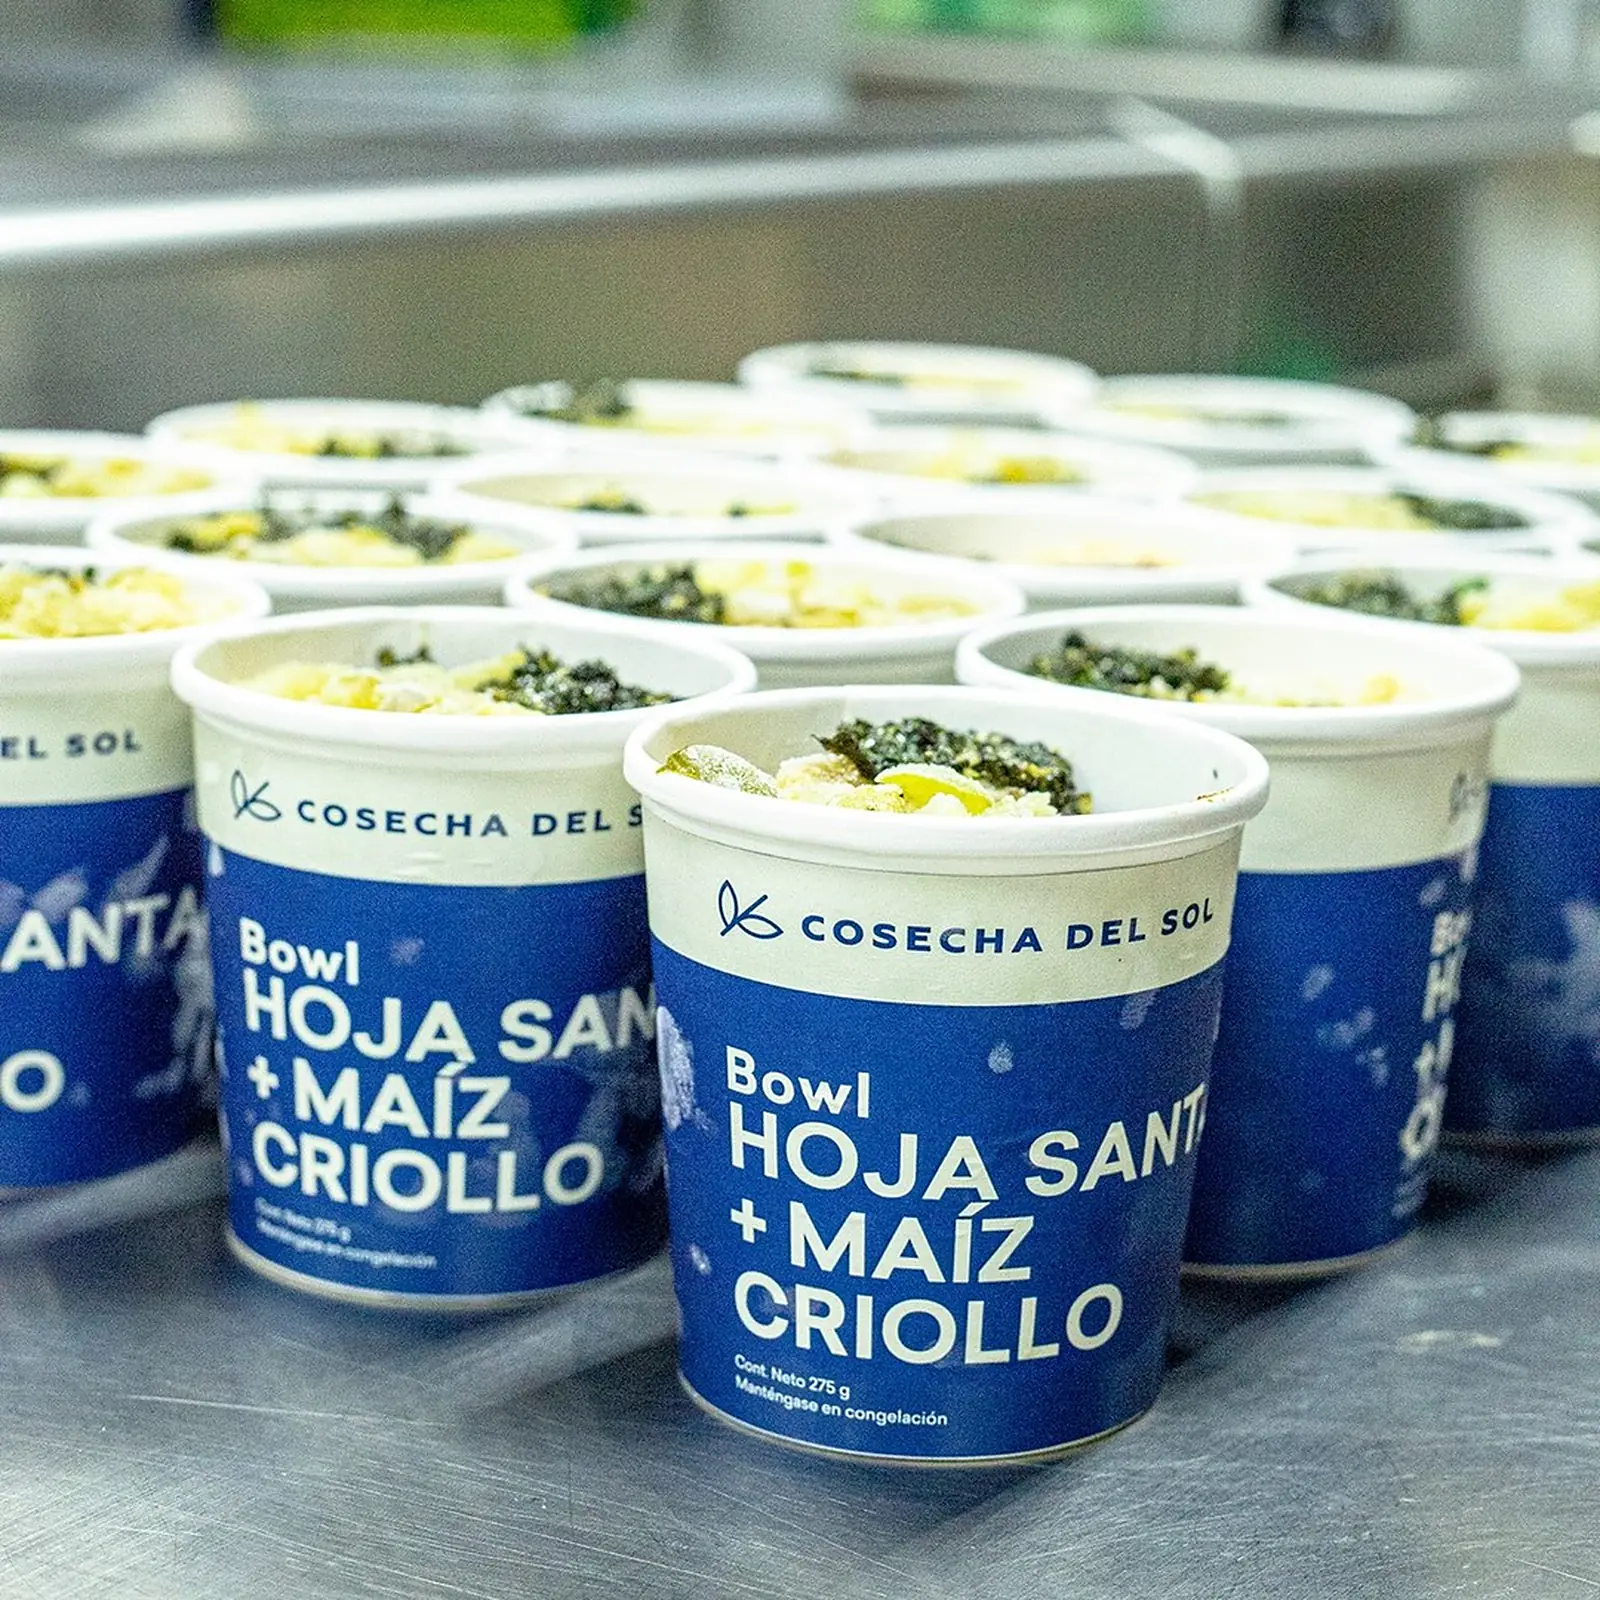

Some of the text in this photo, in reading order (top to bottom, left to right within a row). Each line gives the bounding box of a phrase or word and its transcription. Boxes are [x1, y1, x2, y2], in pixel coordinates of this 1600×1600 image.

[66, 730, 141, 757] SOL
[297, 800, 509, 837] COSECHA
[532, 808, 612, 836] DEL
[239, 916, 360, 985] Bowl
[801, 897, 1214, 954] COSECHA DEL SOL
[243, 967, 476, 1063] HOJA
[247, 1055, 511, 1139] + MAÍZ
[725, 1045, 870, 1119] Bowl
[252, 1121, 605, 1214] CRIOLLO
[728, 1101, 1000, 1201] HOJA
[730, 1198, 1035, 1284] + MAÍZ
[733, 1270, 1124, 1364] CRIOLLO
[735, 1374, 948, 1427] Manténgase en congelación
[771, 1367, 806, 1388] Neto
[808, 1376, 836, 1395] 275
[839, 1386, 850, 1400] g
